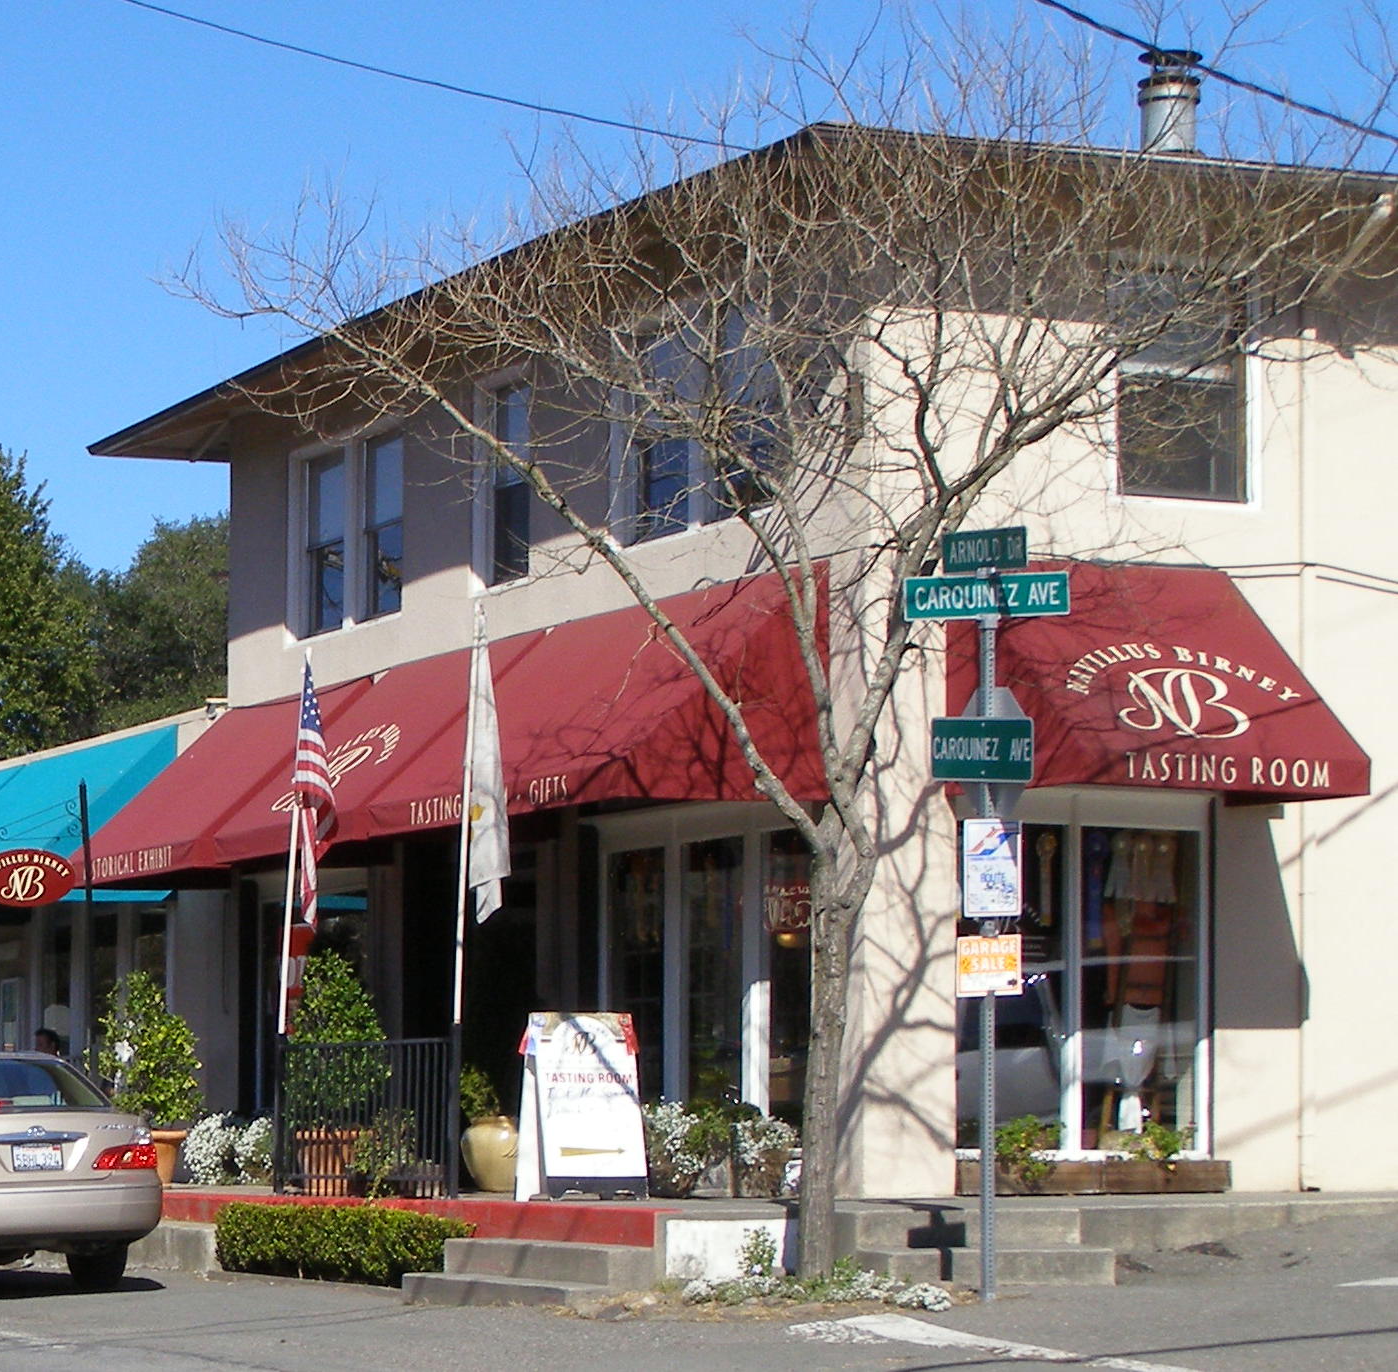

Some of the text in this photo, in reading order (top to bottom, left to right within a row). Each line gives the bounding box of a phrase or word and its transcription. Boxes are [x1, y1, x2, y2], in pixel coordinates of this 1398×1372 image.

[950, 535, 1024, 564] ARNOLD DR
[915, 581, 1061, 612] CARQUINEZ AVE
[1066, 643, 1301, 701] NAVILLUS BIRNEY
[932, 736, 1031, 762] CARQUINEZ AVE
[1125, 751, 1330, 788] TASTING ROOM
[410, 794, 462, 826] TASTING
[529, 775, 568, 805] GIFTS
[33, 854, 70, 878] BIRNEY
[83, 845, 172, 881] STORICAL EXHIBIT
[961, 940, 1017, 955] GARAGE
[970, 956, 1005, 971] SALE
[546, 1072, 634, 1085] TASTING ROOM
